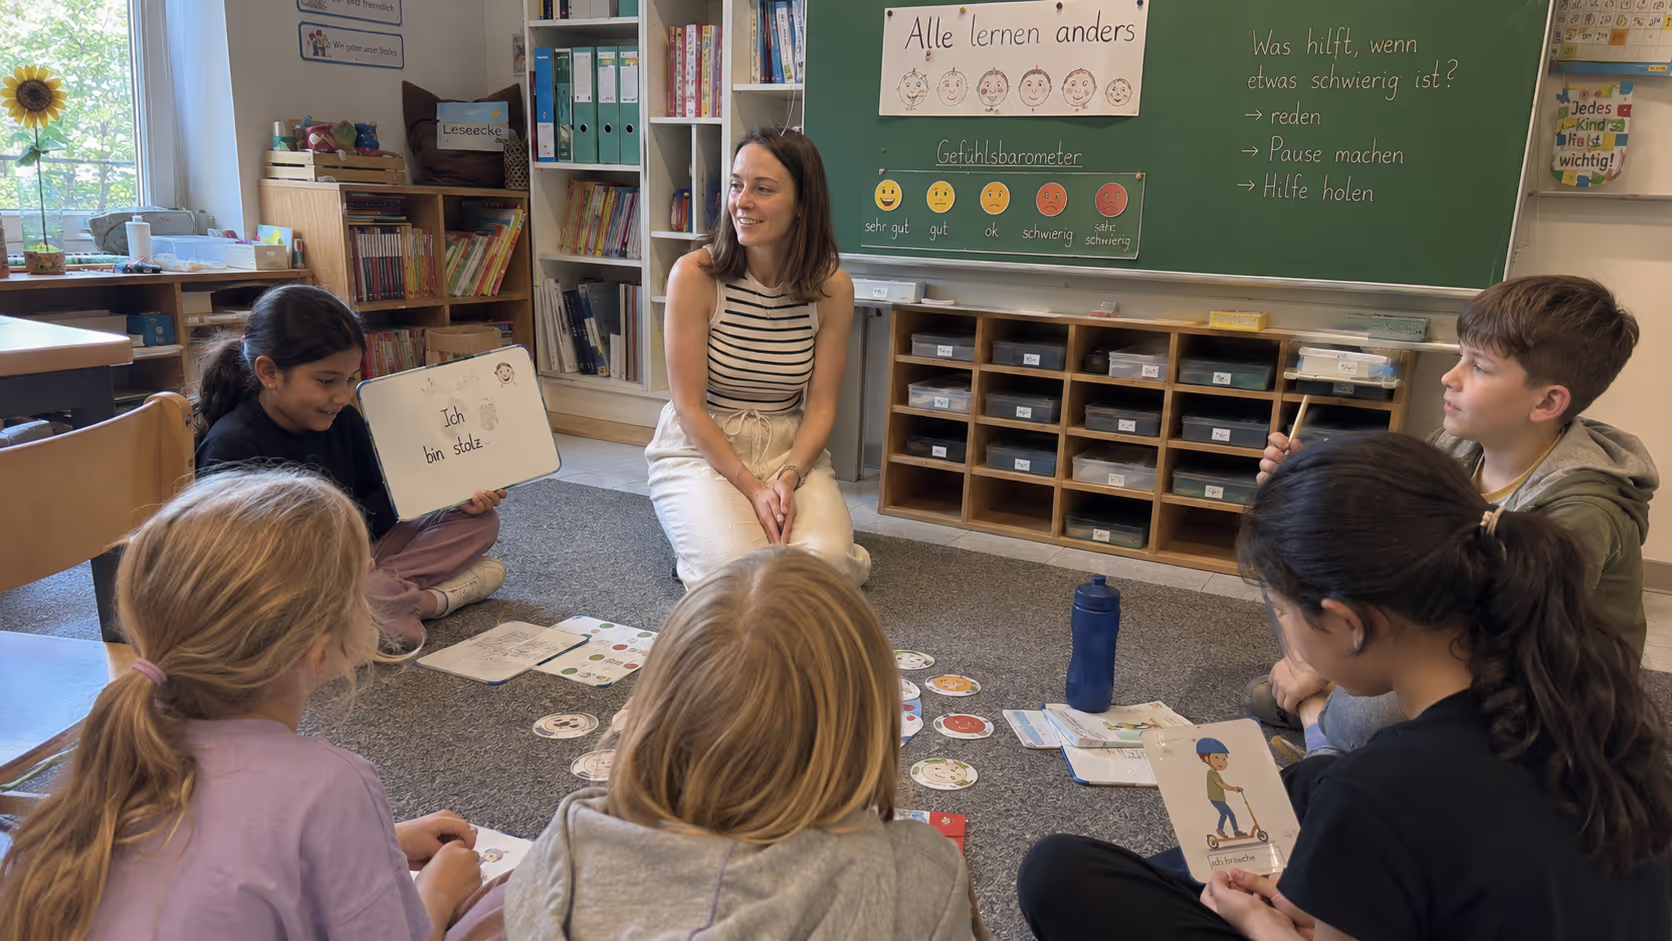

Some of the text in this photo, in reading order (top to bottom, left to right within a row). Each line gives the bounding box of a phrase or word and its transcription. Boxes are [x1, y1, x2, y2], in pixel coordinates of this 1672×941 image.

[905, 10, 1136, 49] Alle lernen anders
[1252, 27, 1418, 59] Was hilft, wenn
[1247, 65, 1297, 89] etwas
[1310, 63, 1399, 101] schwierig
[1270, 100, 1321, 125] reden
[1571, 100, 1612, 115] Jedes
[443, 124, 502, 137] Leseecke
[1576, 118, 1606, 132] Kind
[936, 139, 1082, 166] Gefühlsbarometer
[1269, 135, 1405, 164] Pause machen
[1560, 153, 1614, 171] wichtig!
[1263, 173, 1374, 201] Hilfe holen
[865, 218, 910, 240] sehr gut
[930, 220, 949, 241] gut
[984, 222, 999, 237] ok
[1022, 224, 1073, 247] schwierig
[440, 405, 465, 428] Ich
[423, 433, 483, 464] bin stolz
